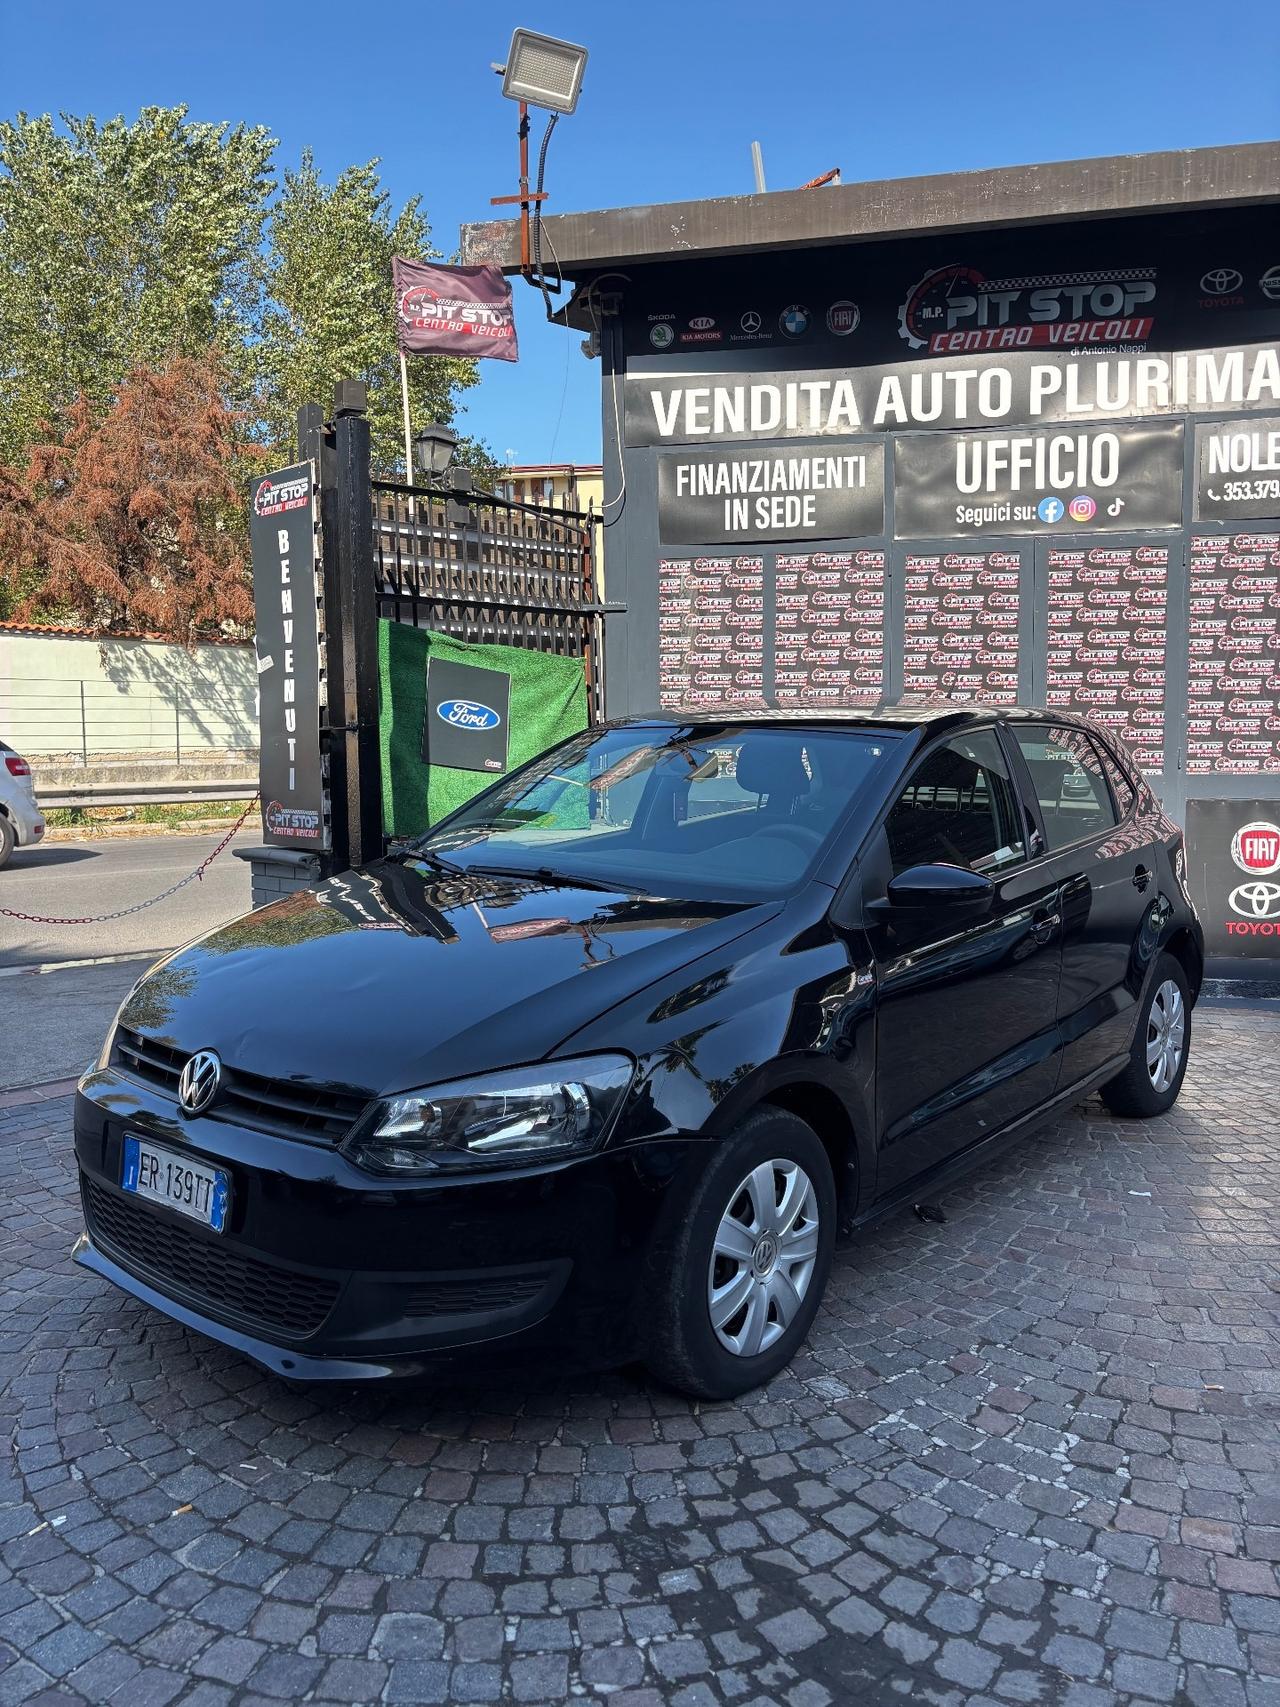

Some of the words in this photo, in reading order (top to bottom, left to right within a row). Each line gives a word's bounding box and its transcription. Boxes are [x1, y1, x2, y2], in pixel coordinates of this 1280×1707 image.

[421, 302, 458, 319] PIT
[922, 307, 944, 319] M.P.
[947, 291, 1021, 331] PIT
[1028, 281, 1157, 322] STOP
[692, 318, 715, 329] KIA
[834, 310, 854, 326] FIAT
[682, 333, 694, 341] KIA
[695, 332, 721, 340] MOTORS
[932, 326, 1033, 352] CENTRO
[1048, 319, 1146, 344] VEICOLI
[1070, 347, 1079, 356] di
[1081, 345, 1118, 356] Antonio
[1120, 343, 1147, 355] Nappi
[650, 379, 861, 437] VENDITA
[873, 368, 1011, 425] AUTO
[1029, 348, 1280, 416] PLURIMA
[1209, 431, 1280, 474] NOLE
[956, 432, 1120, 494] UFFICIO
[676, 455, 866, 497] FINANZIAMENTI
[263, 490, 280, 507] PIT
[280, 483, 308, 502] STOP
[724, 498, 749, 531] IN
[755, 494, 816, 530] SEDE
[956, 502, 1010, 527] Seguici
[1013, 506, 1036, 520] su:
[1243, 598, 1264, 606] STOP
[1254, 620, 1276, 628] STOP
[1241, 639, 1263, 647] STOP
[277, 529, 296, 790] BENVENUTI
[1144, 650, 1165, 658] STOP
[1204, 662, 1225, 670] STOP
[1253, 661, 1275, 669] STOP
[1240, 680, 1262, 688] STOP
[1143, 690, 1164, 698] STOP
[1252, 702, 1273, 710] STOP
[449, 703, 488, 727] Ford
[1142, 730, 1164, 738] STOP
[1238, 761, 1259, 769] STOP
[275, 813, 290, 827] PIT
[291, 815, 319, 829] STOP
[1245, 838, 1278, 860] FIAT
[138, 1151, 160, 1191] ER
[166, 1162, 214, 1213] 139TT
